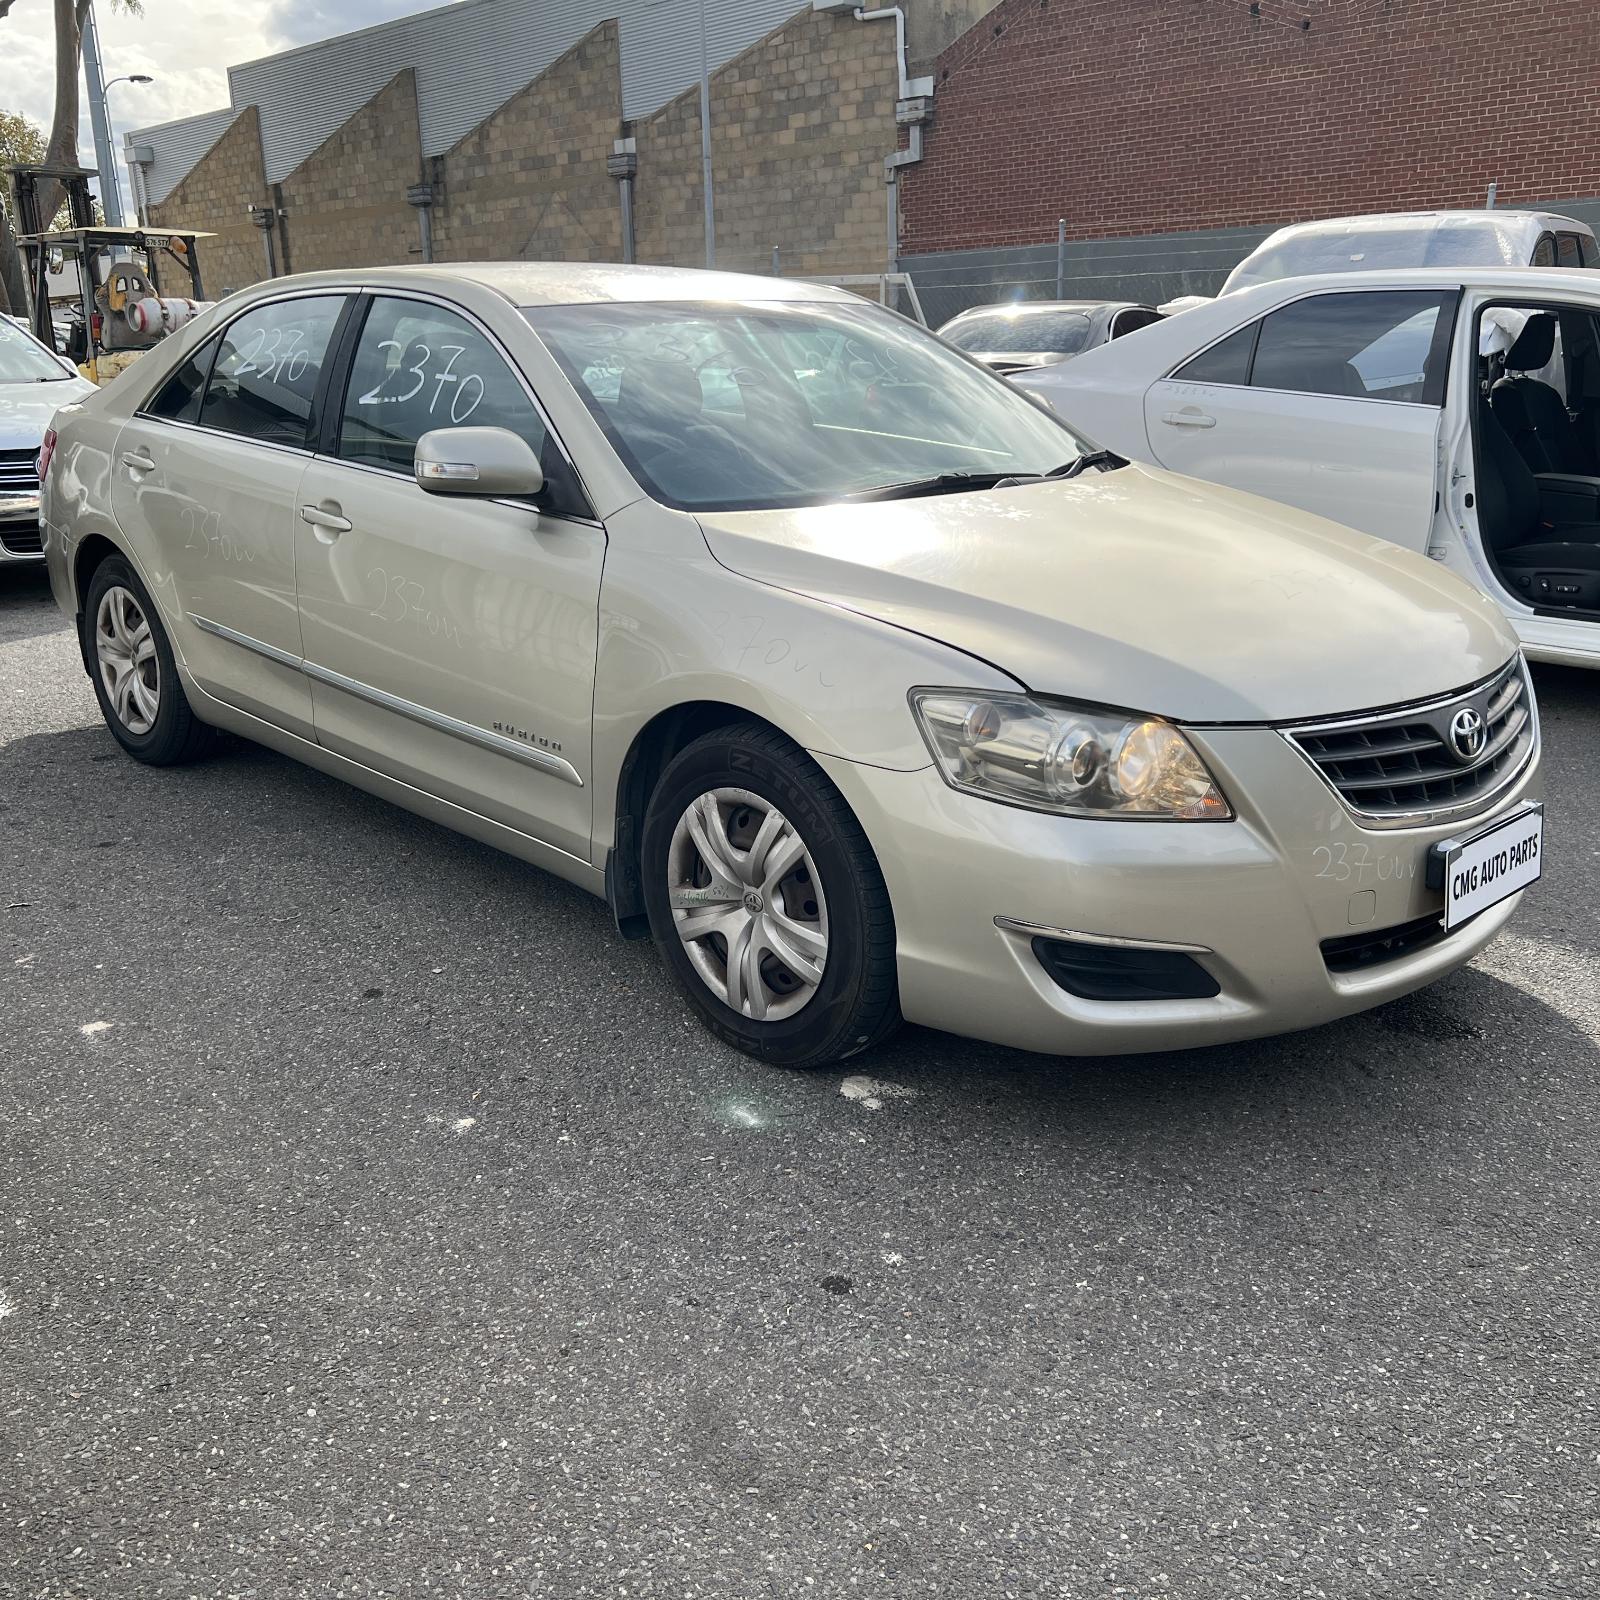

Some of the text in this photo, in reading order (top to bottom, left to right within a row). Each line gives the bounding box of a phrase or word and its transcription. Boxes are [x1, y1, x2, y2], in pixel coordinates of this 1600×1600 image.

[234, 328, 310, 384] 2370
[358, 340, 485, 424] 2370
[1452, 833, 1539, 901] CMG AUTO PARTS
